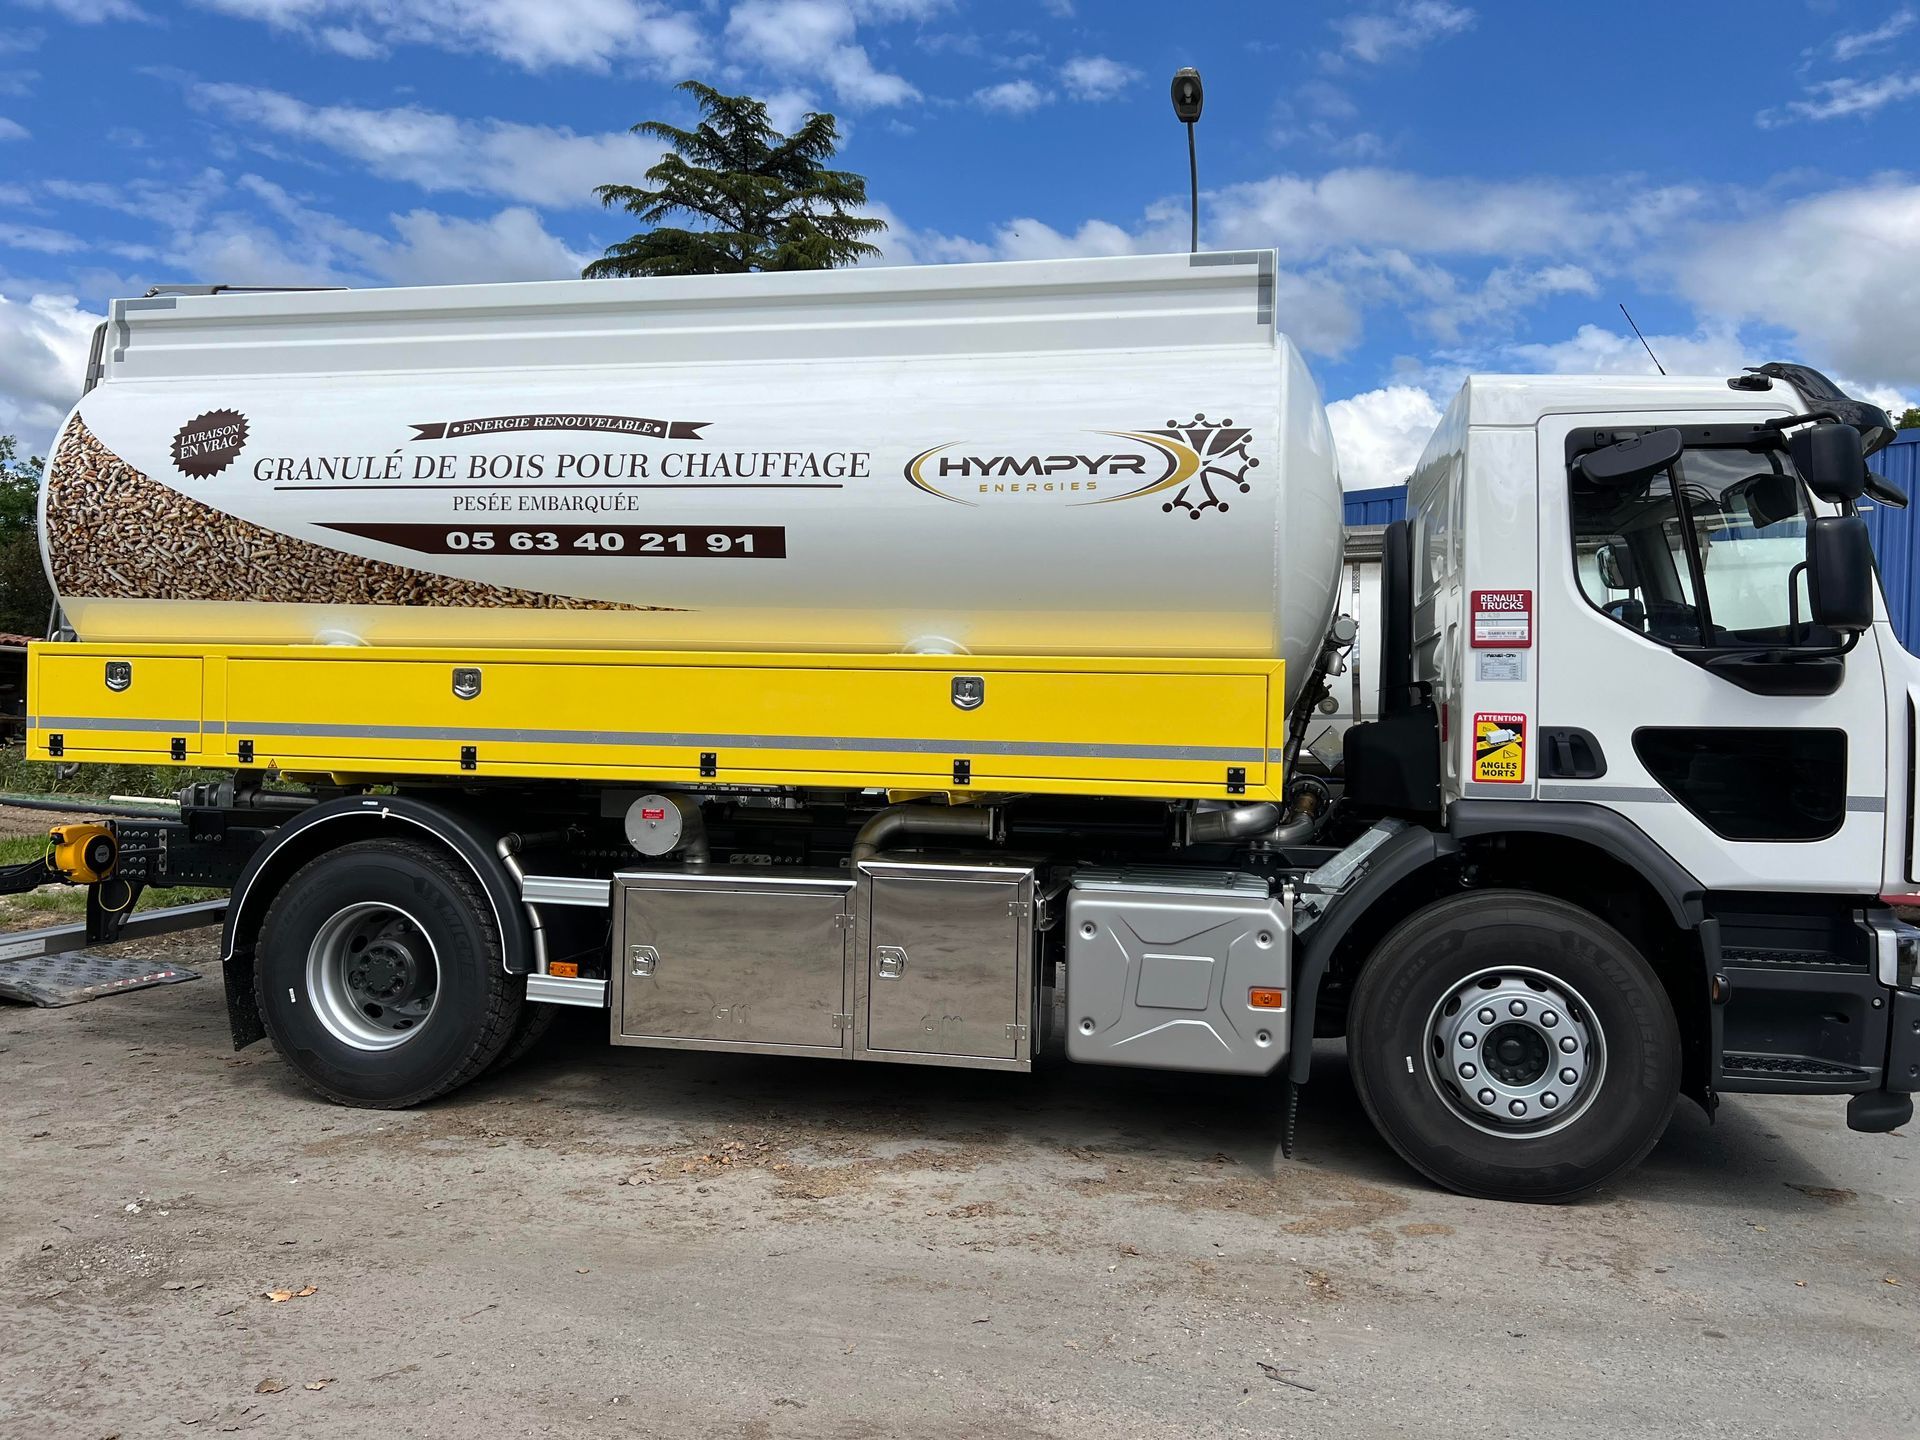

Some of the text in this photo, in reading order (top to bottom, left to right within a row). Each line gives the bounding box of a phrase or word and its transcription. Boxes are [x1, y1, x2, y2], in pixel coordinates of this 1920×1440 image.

[180, 423, 241, 447] LIVRAISON
[462, 416, 653, 434] ENERGIE RENOUVELABLE
[180, 434, 239, 460] EN VRAC
[253, 449, 871, 482] GRANULÉ DE BOIS POUR CHAUFFAGE
[939, 454, 1146, 477] HYMPYR
[979, 481, 1097, 493] ENERGIES
[452, 492, 639, 513] PESÉE EMBARQUÉE
[445, 531, 755, 553] 05 63 40 21 91
[1480, 594, 1524, 602] RENAULT
[1480, 602, 1524, 610] TRUCKS
